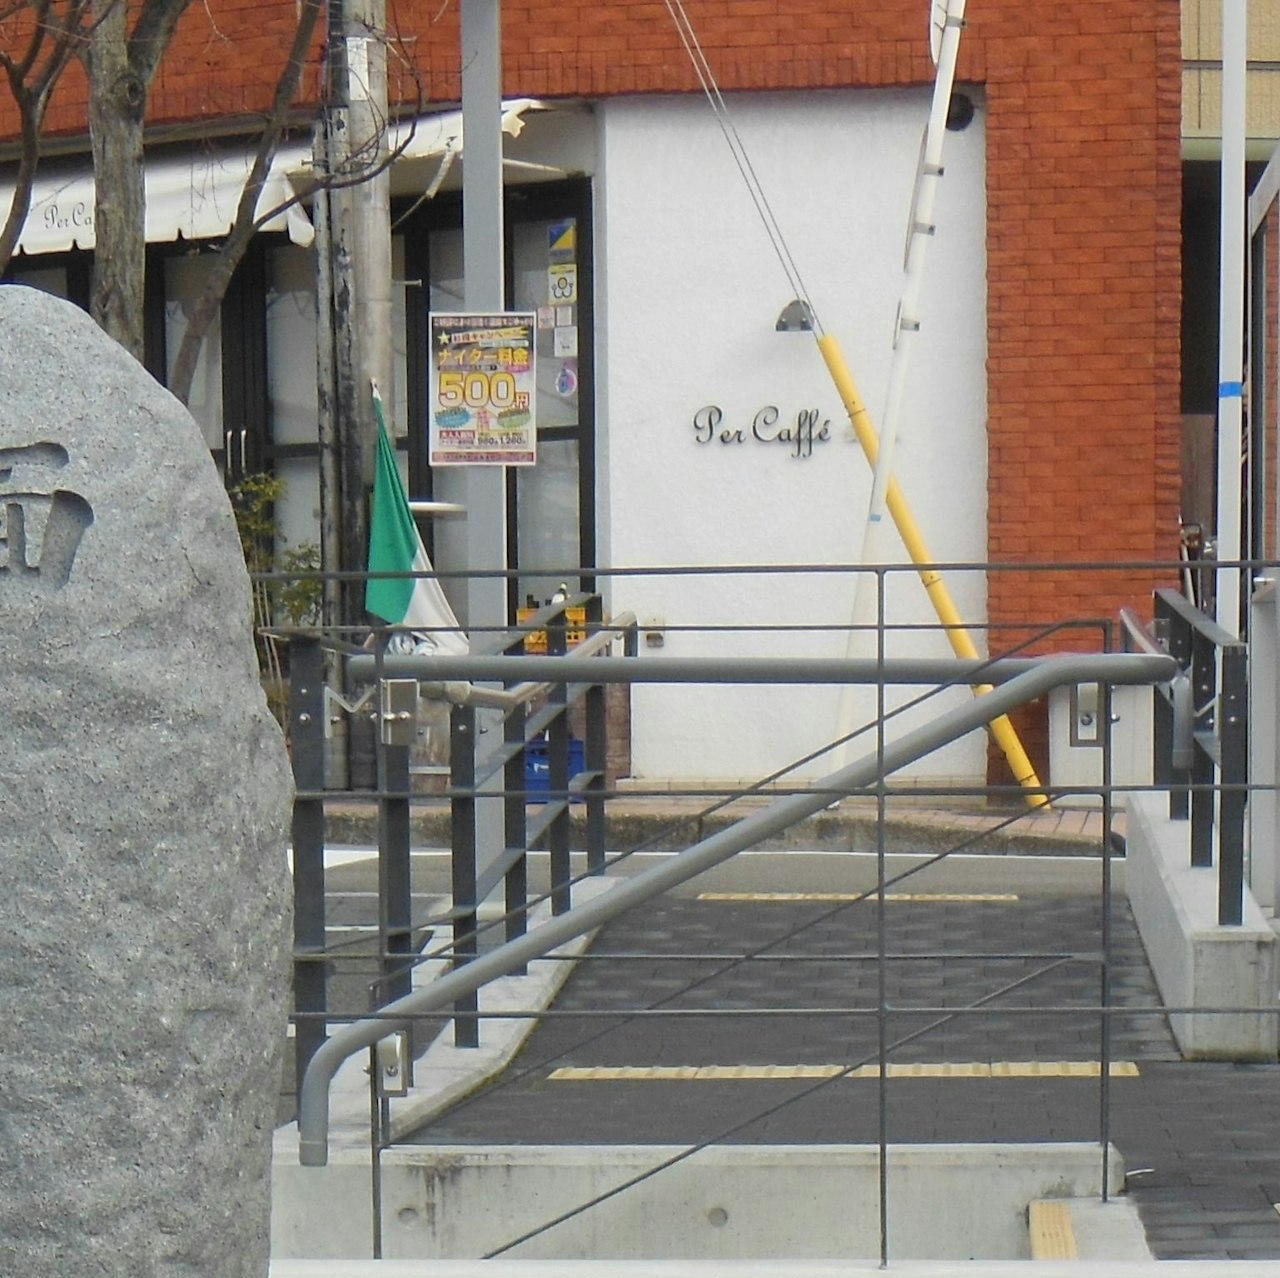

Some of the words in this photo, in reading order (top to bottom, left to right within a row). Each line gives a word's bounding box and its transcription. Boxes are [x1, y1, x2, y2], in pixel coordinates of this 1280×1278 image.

[43, 203, 69, 230] Per
[438, 348, 528, 366] ナイター料金
[693, 405, 747, 444] Per
[752, 405, 832, 458] Caffé
